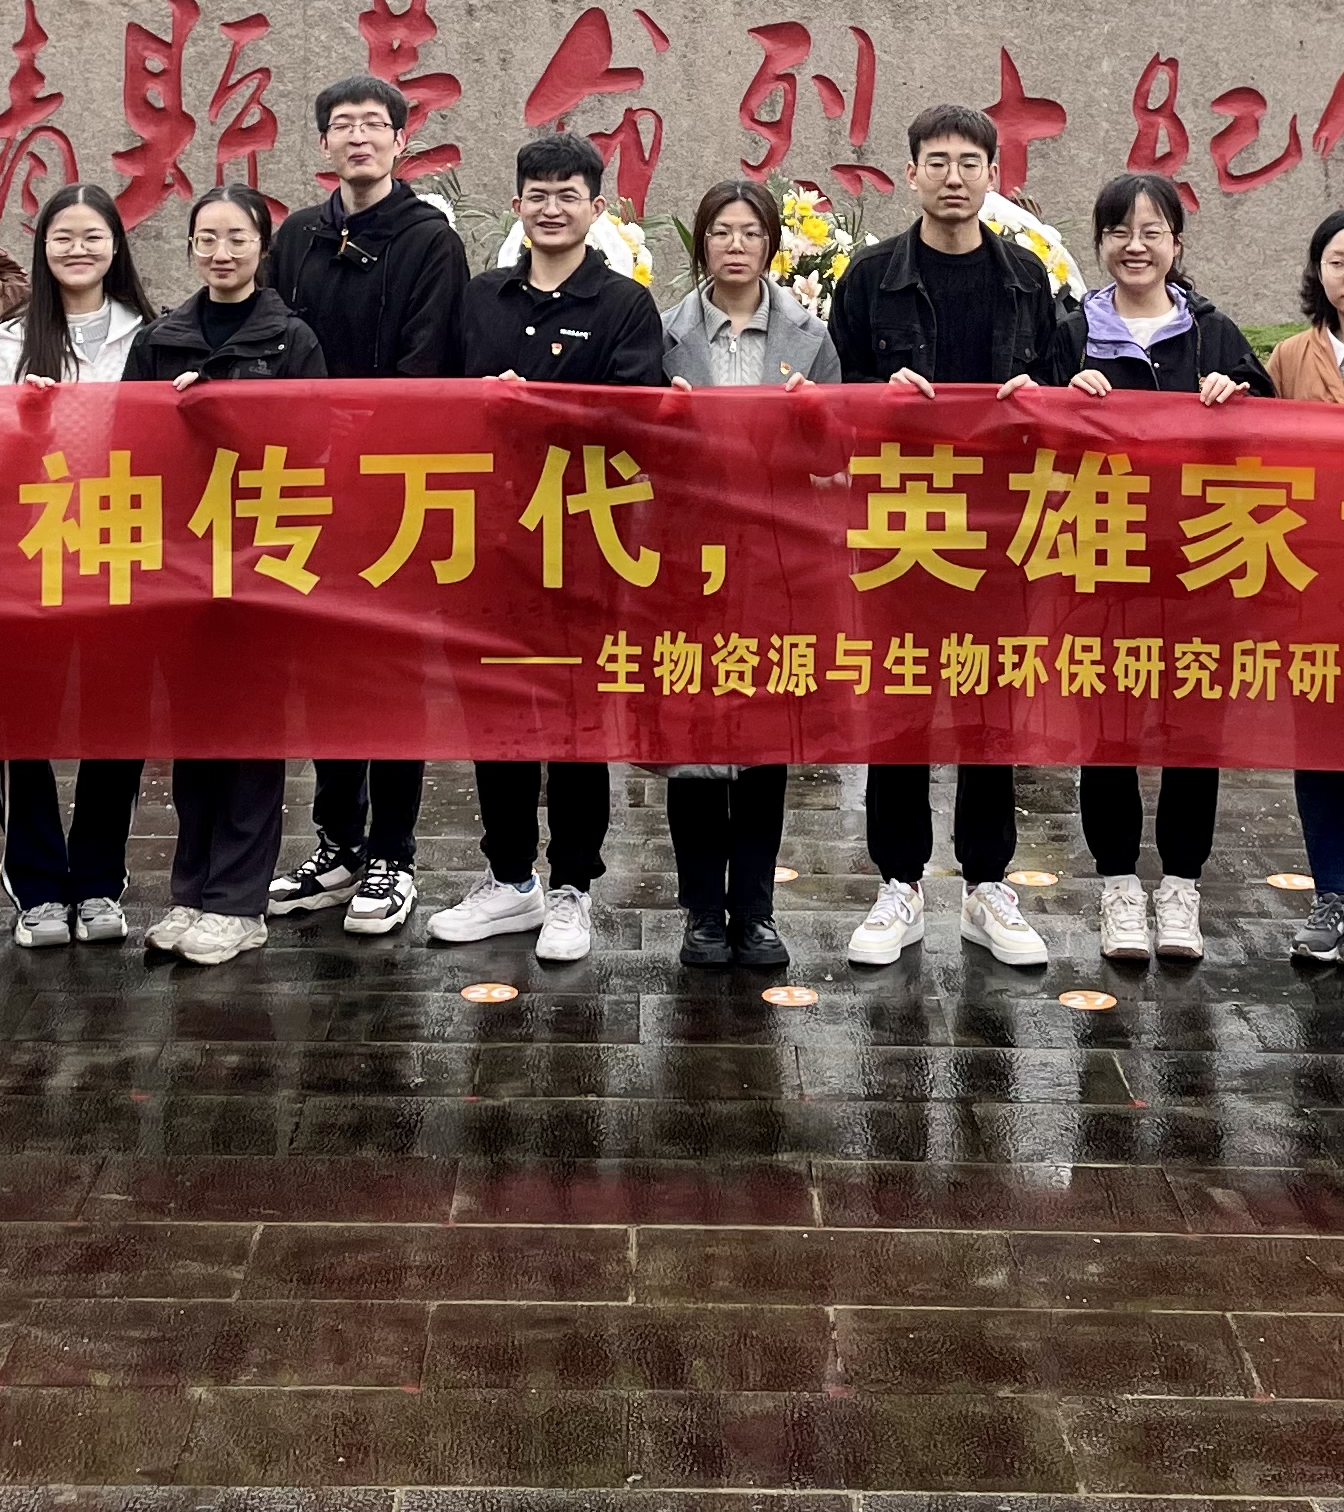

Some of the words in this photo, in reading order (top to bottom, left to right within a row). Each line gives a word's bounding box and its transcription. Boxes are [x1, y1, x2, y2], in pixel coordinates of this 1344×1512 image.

[467, 987, 513, 999] 26
[769, 990, 812, 1002] 25
[1065, 994, 1110, 1006] 27
